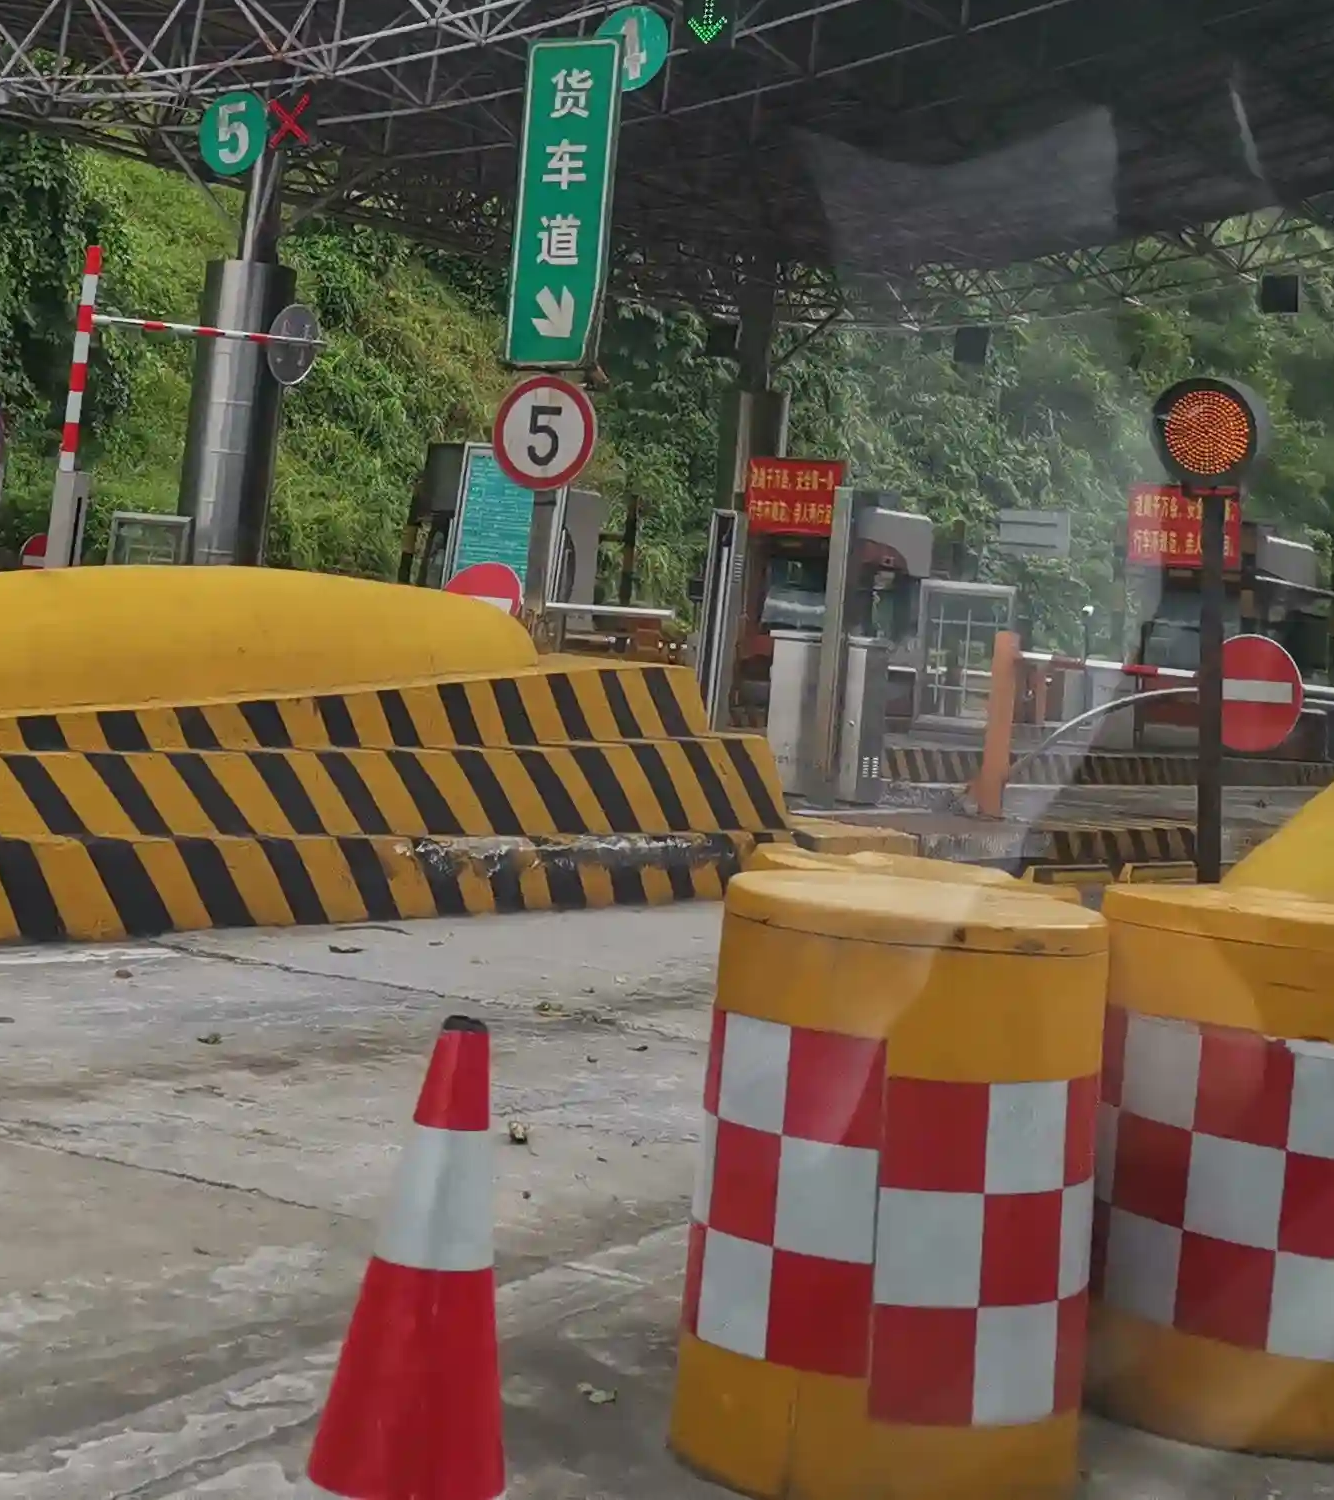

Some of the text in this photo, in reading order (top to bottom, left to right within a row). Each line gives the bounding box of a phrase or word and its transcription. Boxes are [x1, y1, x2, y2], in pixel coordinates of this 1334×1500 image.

[217, 101, 249, 163] 5
[535, 67, 596, 267] 货车道
[526, 406, 564, 467] 5
